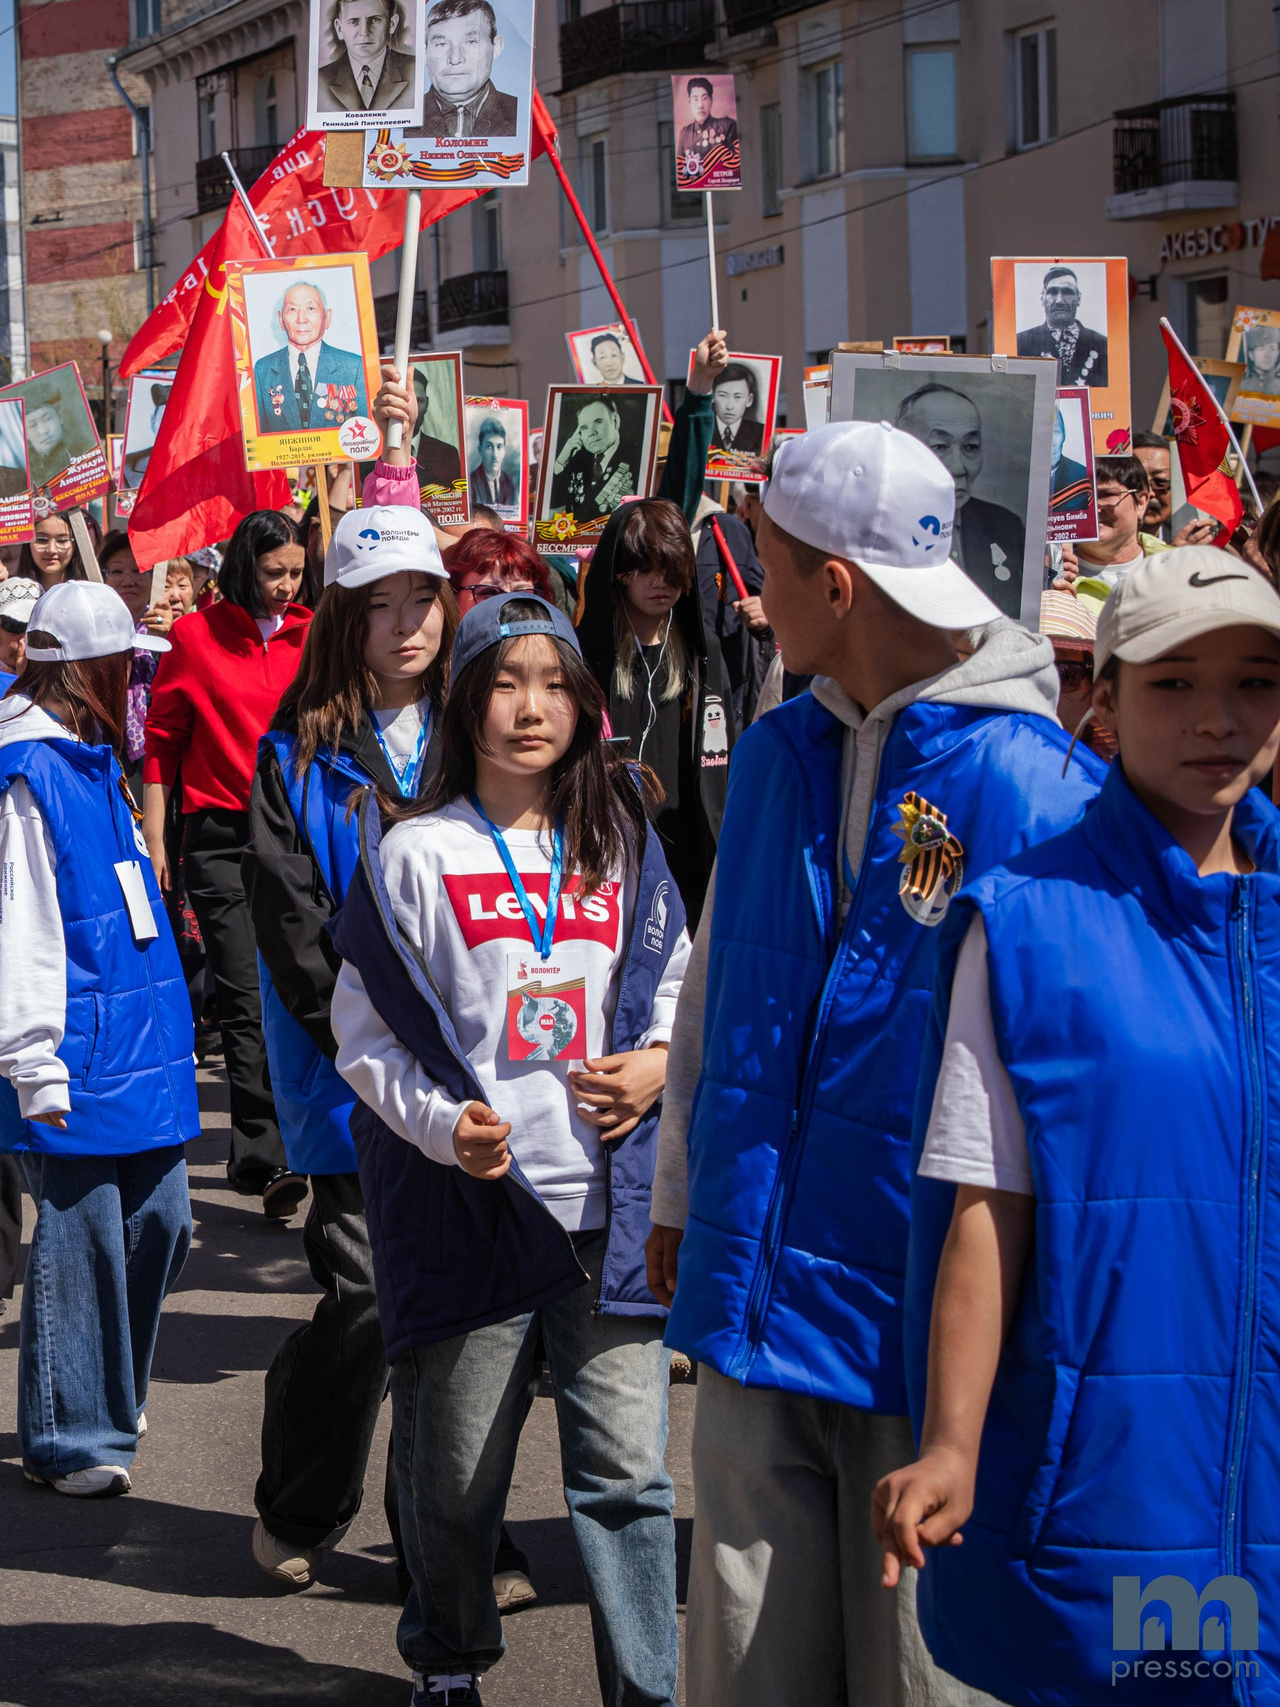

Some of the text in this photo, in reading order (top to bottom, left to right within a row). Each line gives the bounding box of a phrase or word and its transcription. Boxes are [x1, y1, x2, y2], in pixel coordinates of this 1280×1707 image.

[435, 136, 488, 148] Коломин
[420, 150, 455, 159] Никита
[279, 436, 321, 446] ЯНЖИНОВ
[350, 446, 370, 454] ПОЛК
[55, 474, 110, 502] БЕССМЕРТНЫЙ
[75, 488, 98, 501] ПОЛК
[432, 500, 462, 508] Матвеевич
[437, 514, 466, 524] ПОЛК
[1066, 511, 1087, 520] Бимба
[1054, 532, 1070, 540] 2002
[531, 966, 560, 974] ВОЛОНТЁР
